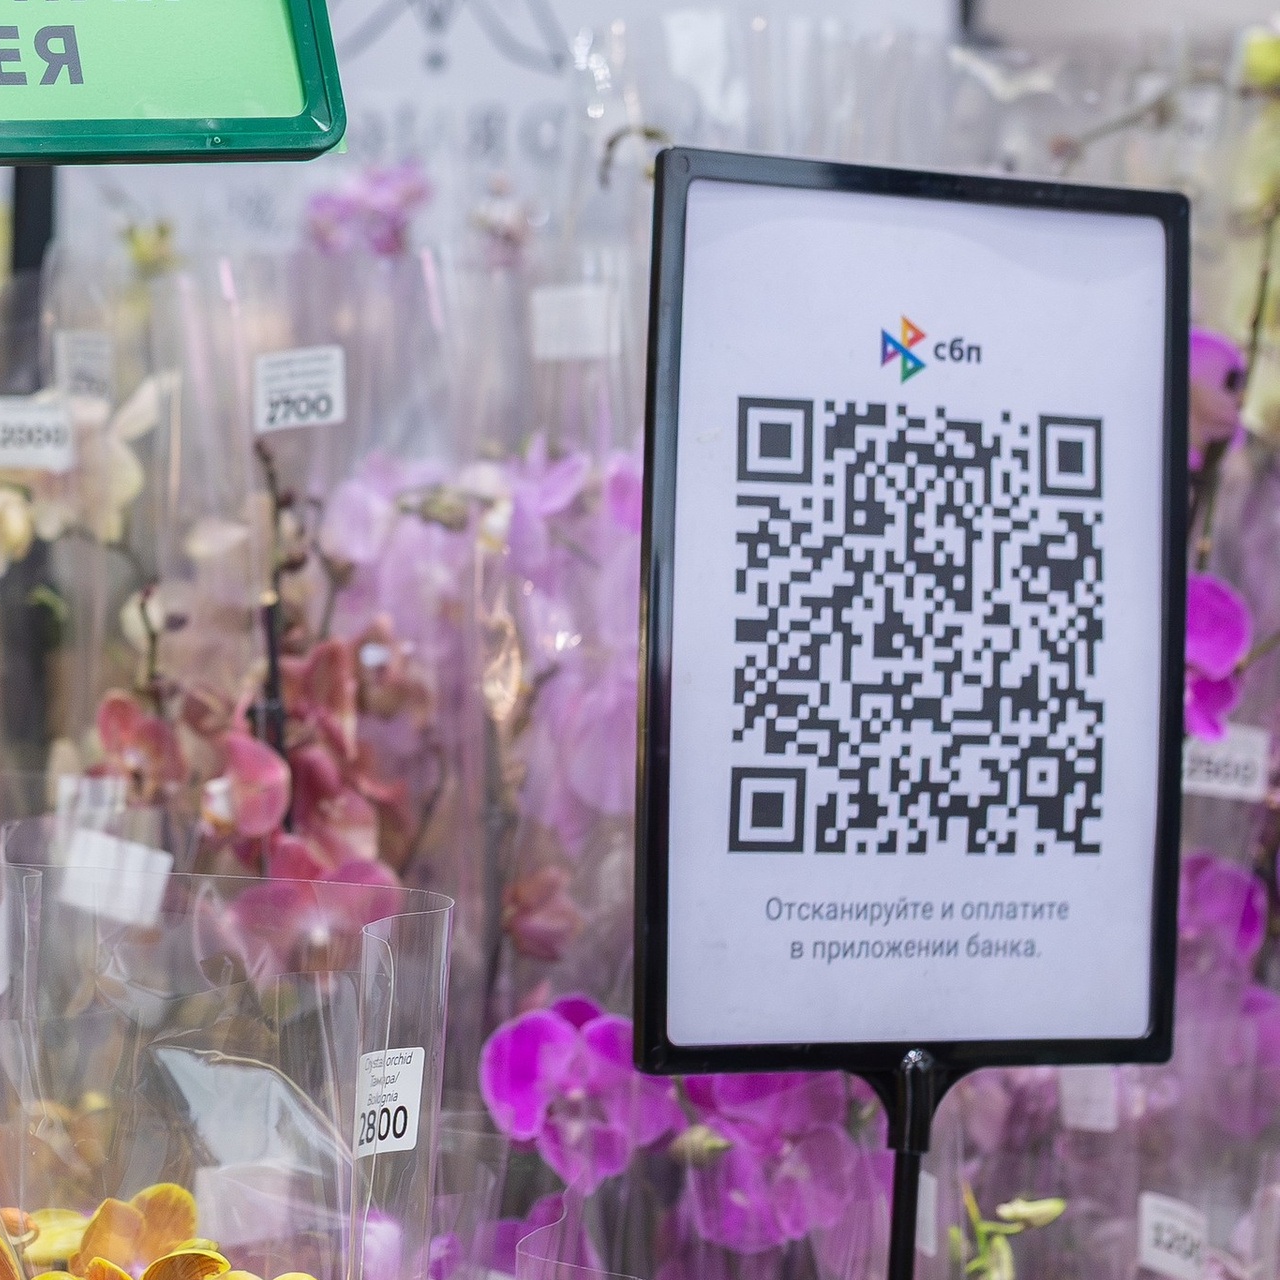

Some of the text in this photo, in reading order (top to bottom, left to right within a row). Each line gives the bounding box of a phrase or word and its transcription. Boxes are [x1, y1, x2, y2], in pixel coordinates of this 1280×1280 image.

[933, 336, 982, 364] сбп
[765, 896, 1070, 926] Отсканируйте и оплатите
[790, 932, 1042, 964] в приложении банка.
[386, 1051, 413, 1067] orchid
[359, 1105, 407, 1146] 2800
